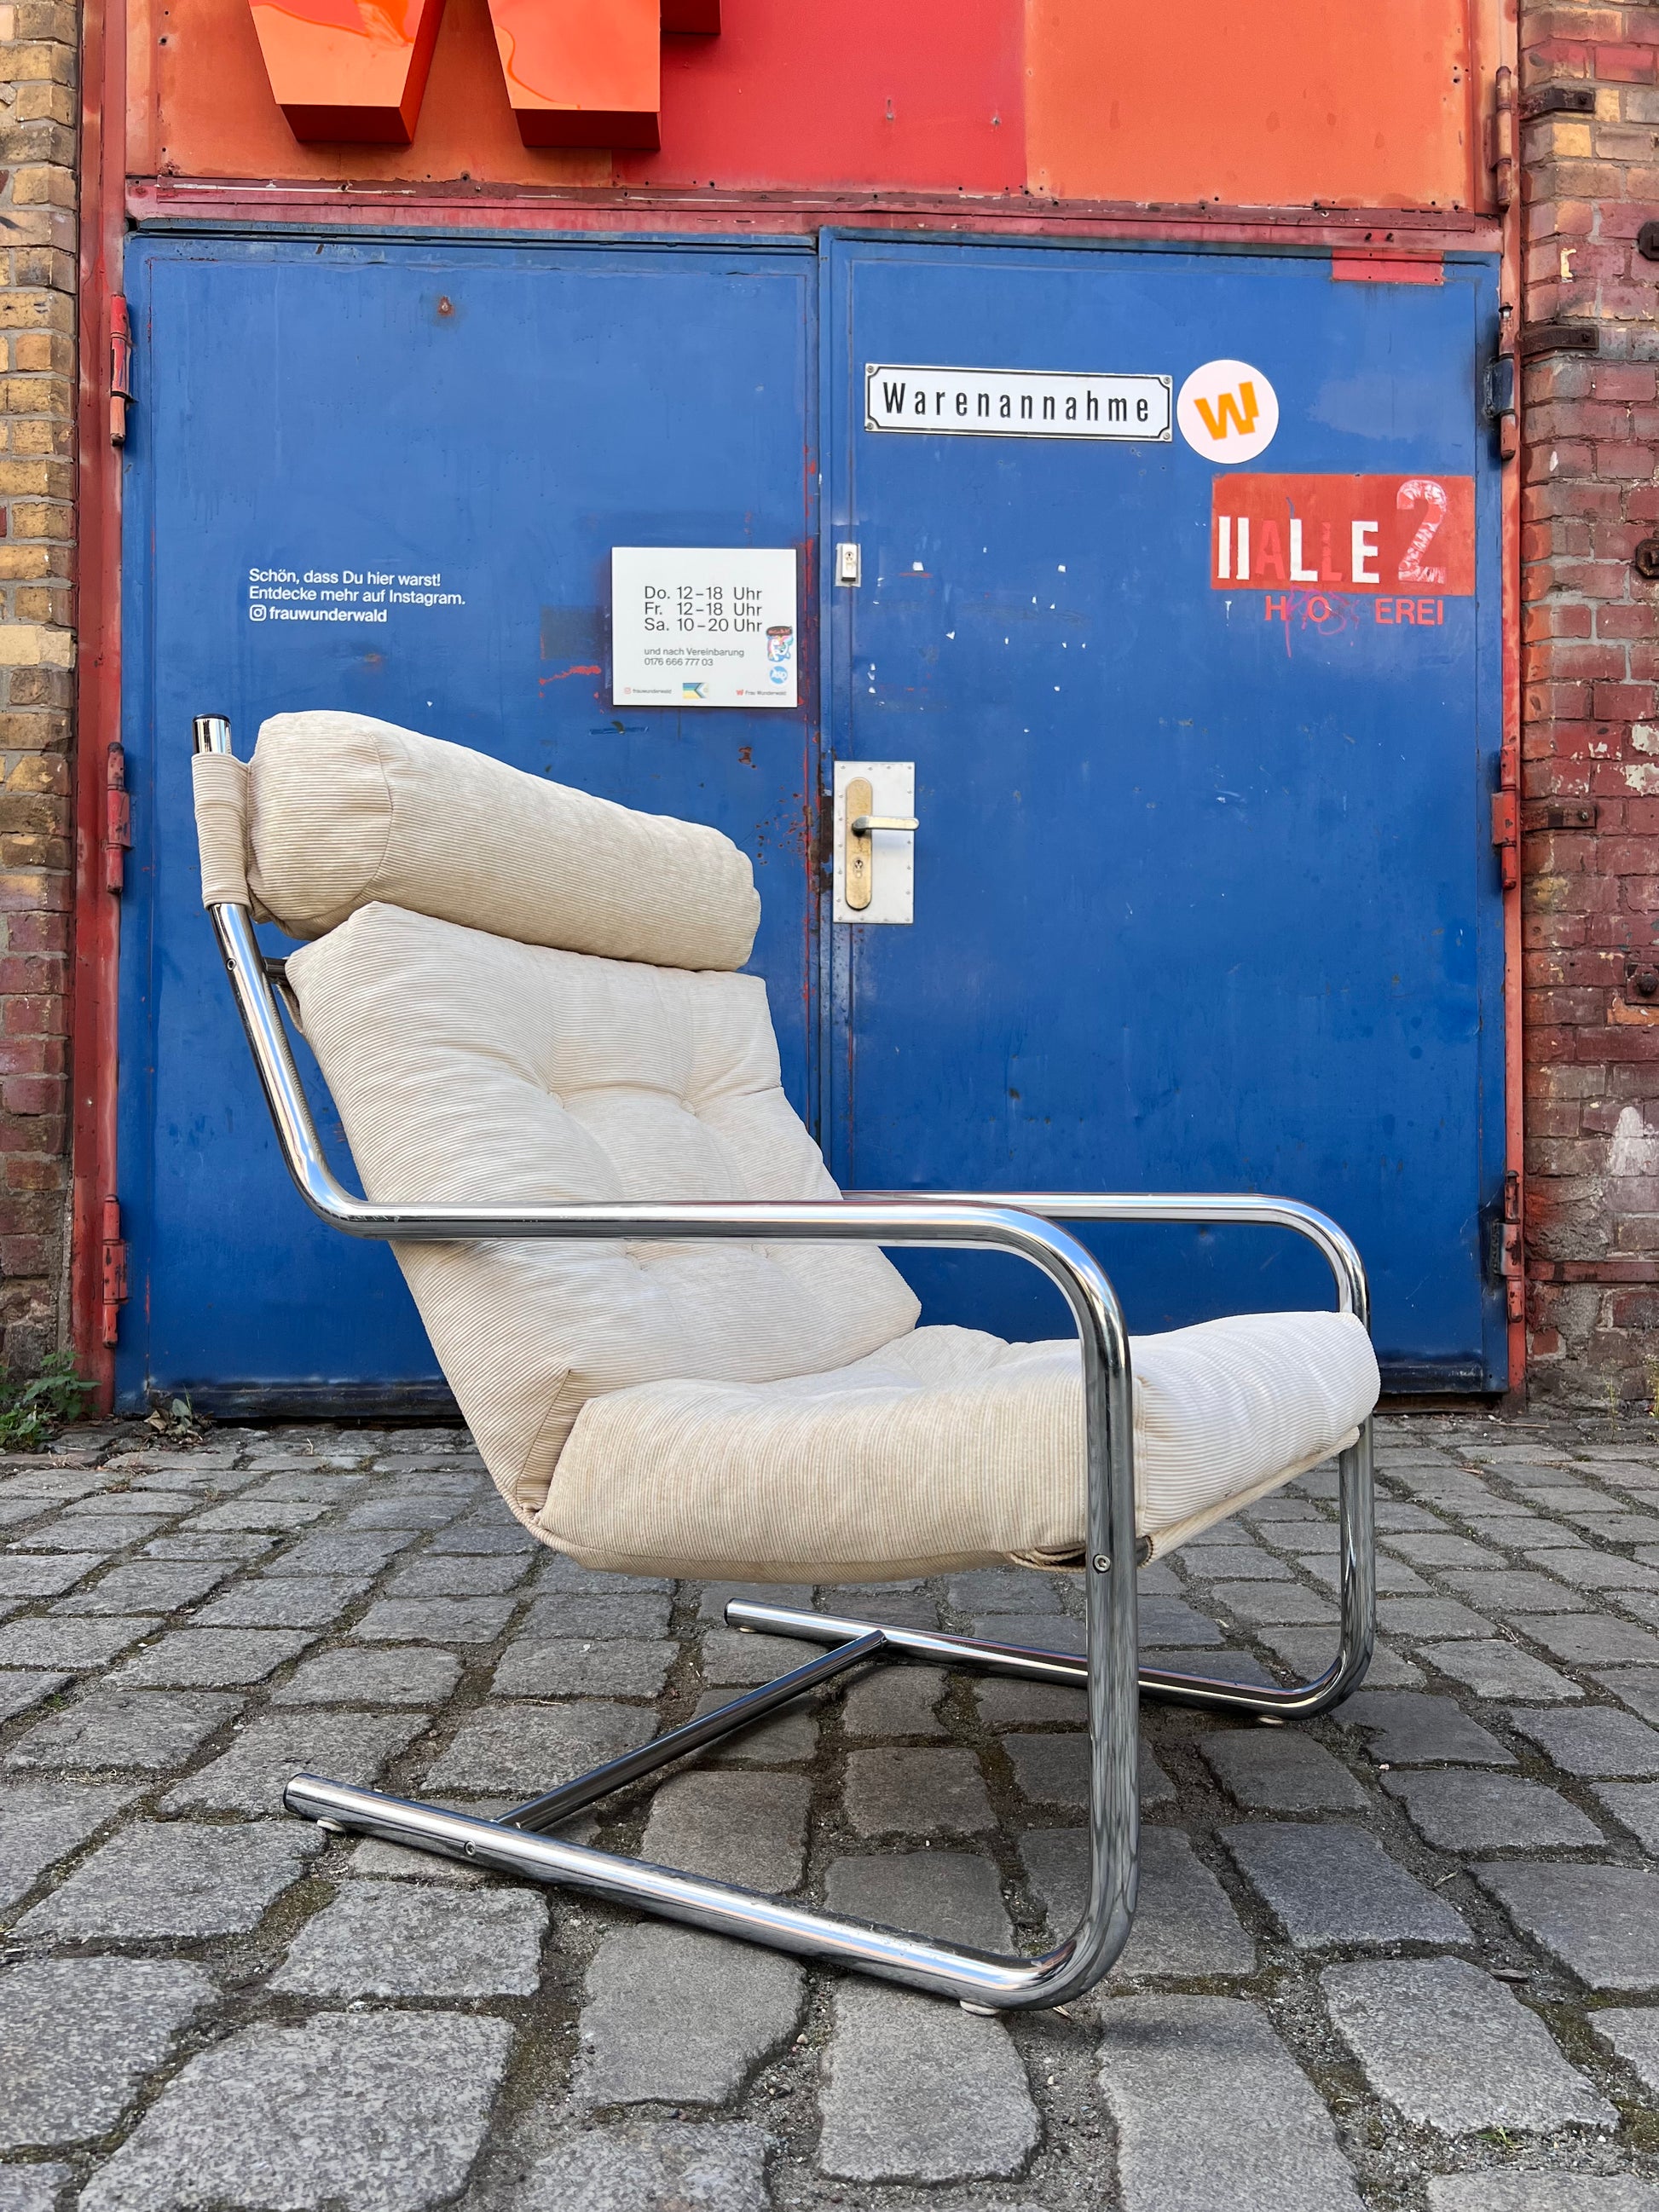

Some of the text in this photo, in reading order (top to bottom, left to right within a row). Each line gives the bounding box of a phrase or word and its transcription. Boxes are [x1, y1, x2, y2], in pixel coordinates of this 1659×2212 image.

[882, 381, 1149, 422] Warenannahme
[1396, 480, 1447, 584] 2
[249, 569, 441, 587] Schön, dass Du hier warst!
[249, 586, 465, 607] Entdecke mehr auf Instagram.
[645, 586, 670, 599] Do.
[733, 586, 762, 600] Uhr
[269, 606, 387, 622] frauwunderwald
[645, 602, 662, 615] Fr.
[733, 603, 762, 616] Uhr
[645, 617, 669, 632] Sa.
[734, 619, 762, 632] Uhr
[686, 648, 744, 658] Vereinbarung
